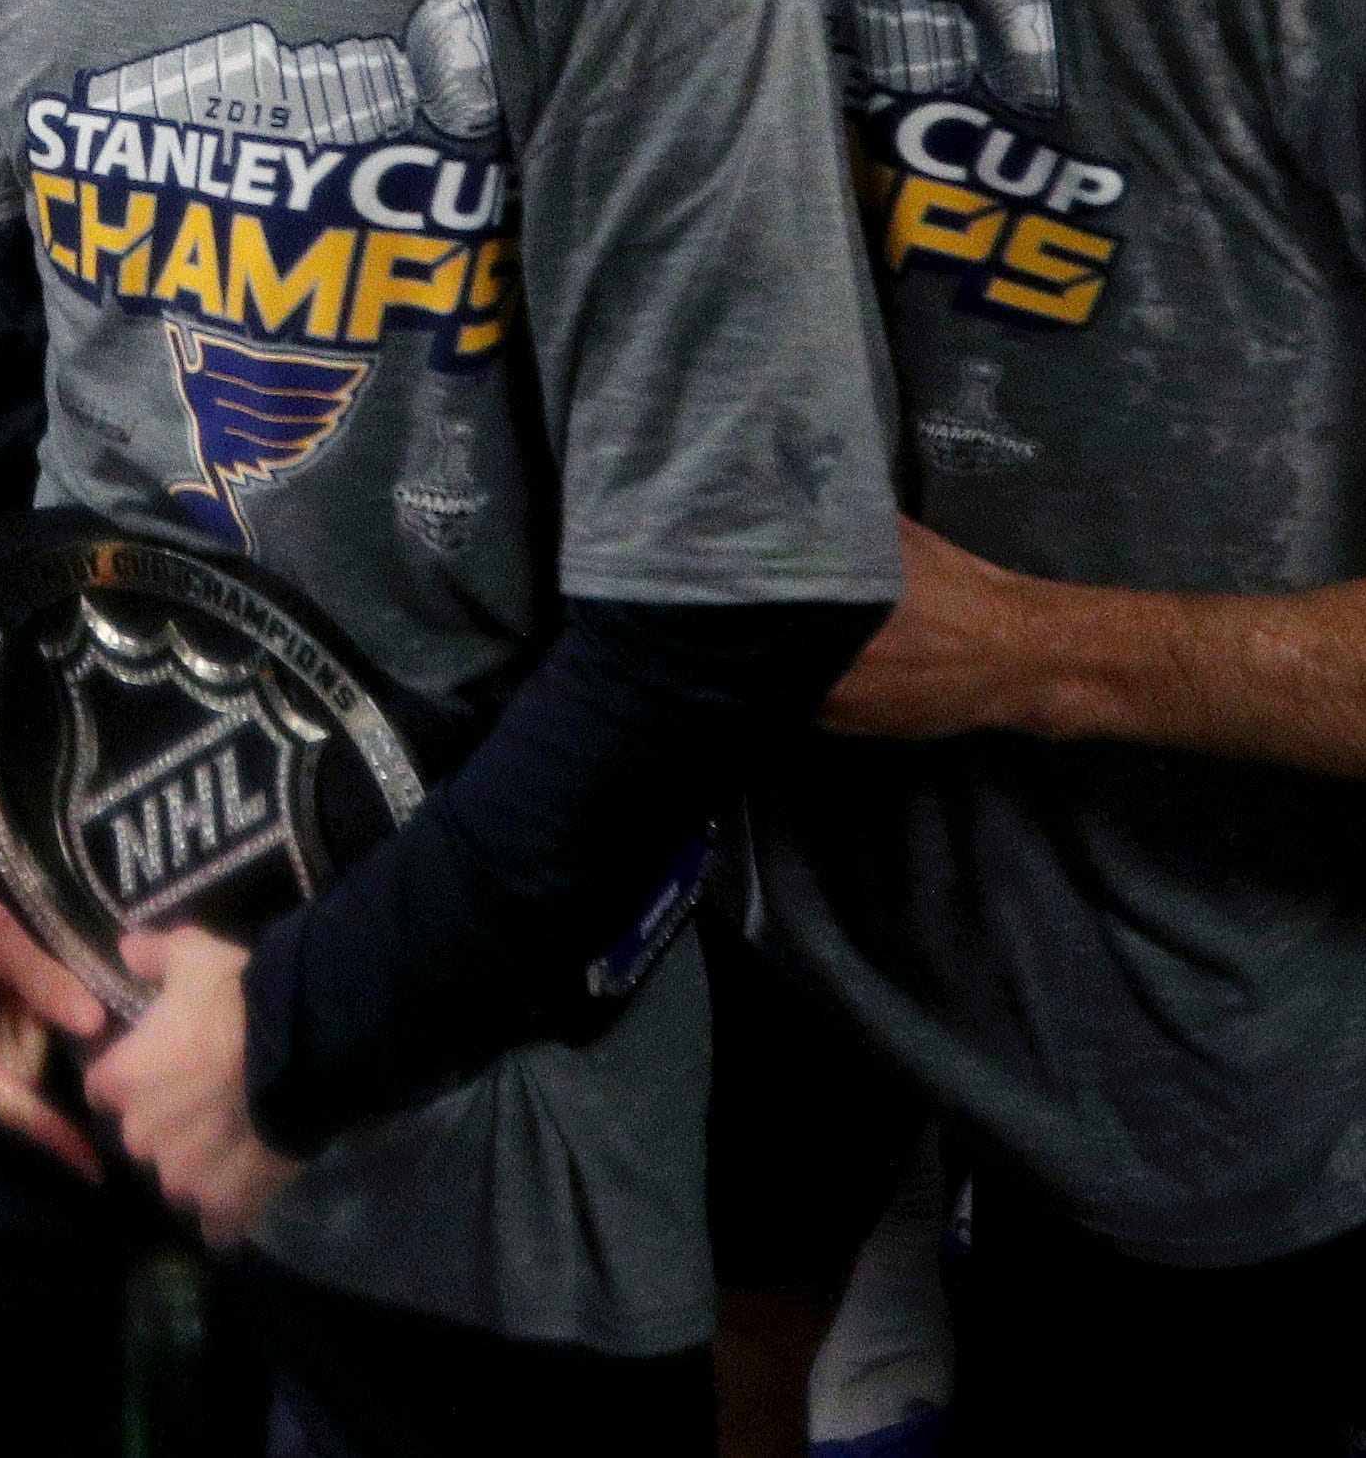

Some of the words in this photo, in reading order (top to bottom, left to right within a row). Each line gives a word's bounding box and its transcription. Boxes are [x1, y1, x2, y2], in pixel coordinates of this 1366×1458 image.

[26, 98, 343, 212] STANLEY
[349, 144, 504, 232] CU
[205, 96, 291, 129] 2019
[895, 100, 1125, 214] CUP
[181, 569, 357, 711] CHAMPIONS
[114, 746, 267, 898] NHL
